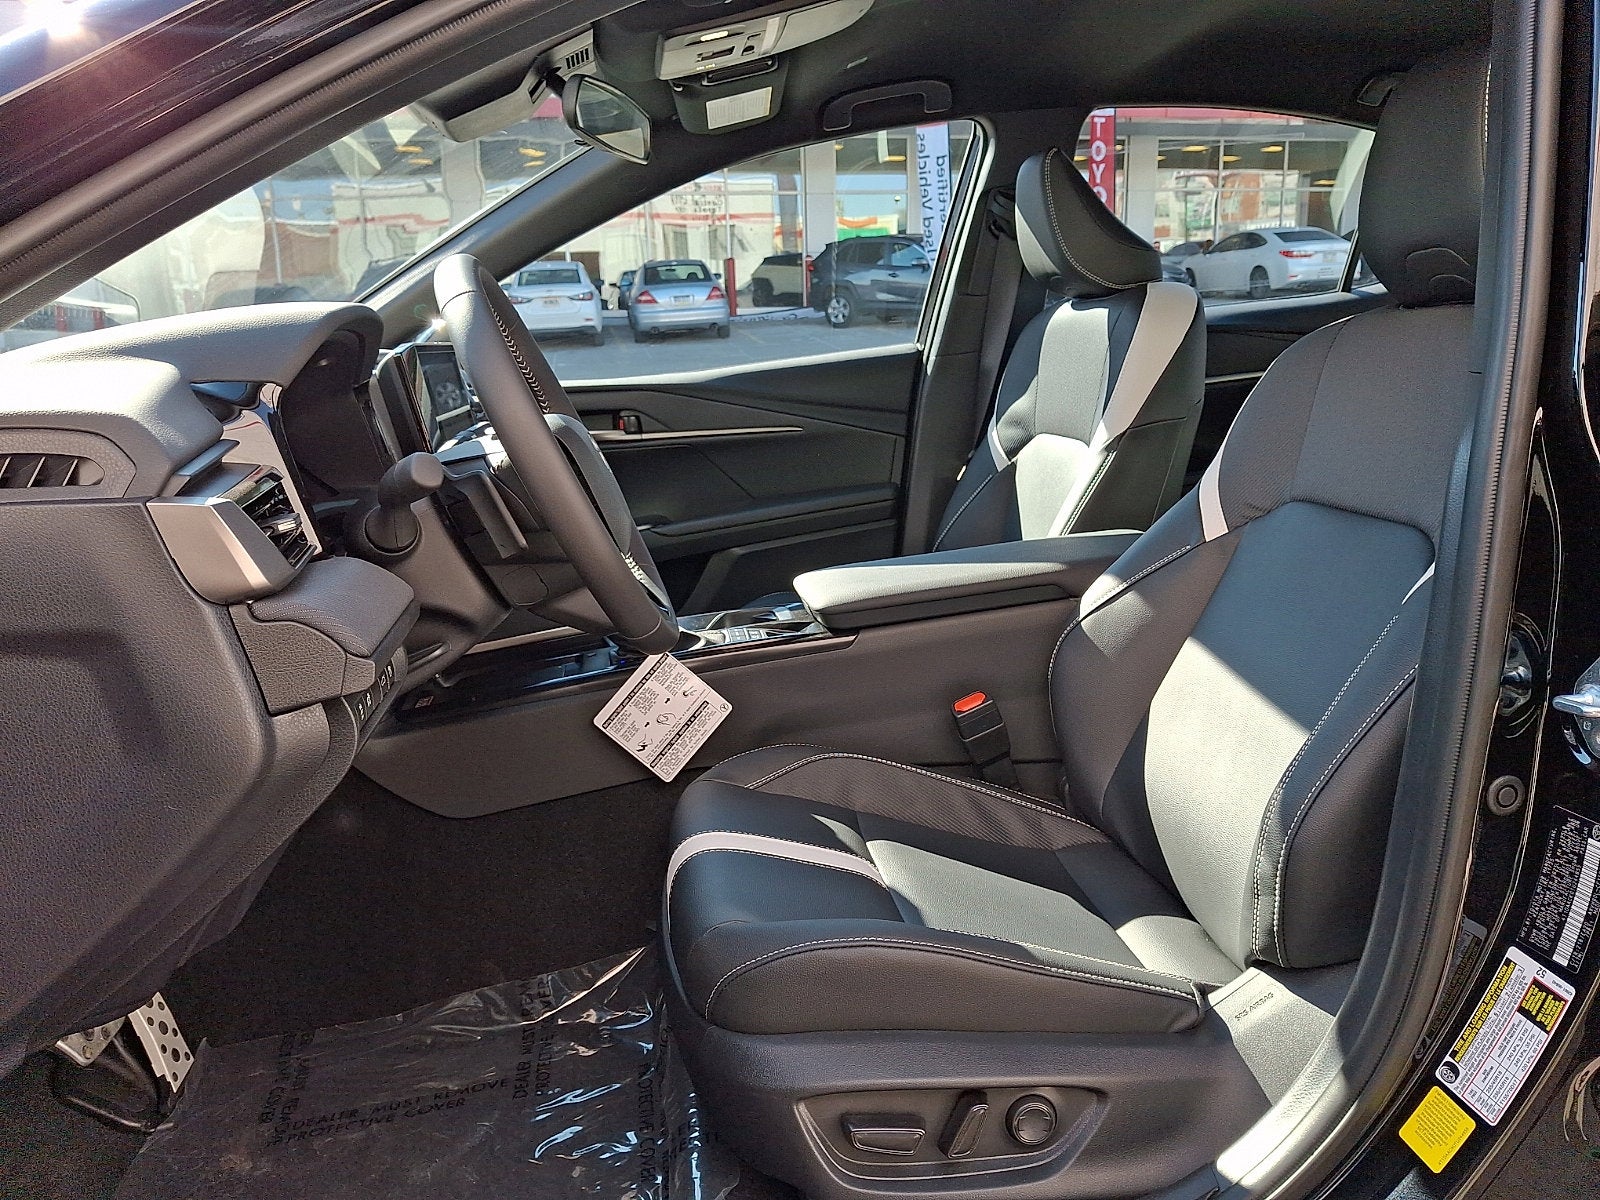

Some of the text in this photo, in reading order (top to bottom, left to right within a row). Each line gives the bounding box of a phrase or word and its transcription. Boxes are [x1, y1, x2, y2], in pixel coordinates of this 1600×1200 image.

[1535, 966, 1547, 979] 52
[1454, 965, 1508, 1051] TIRE AND LOADING INFORMATION
[1478, 1010, 1487, 1020] LES
